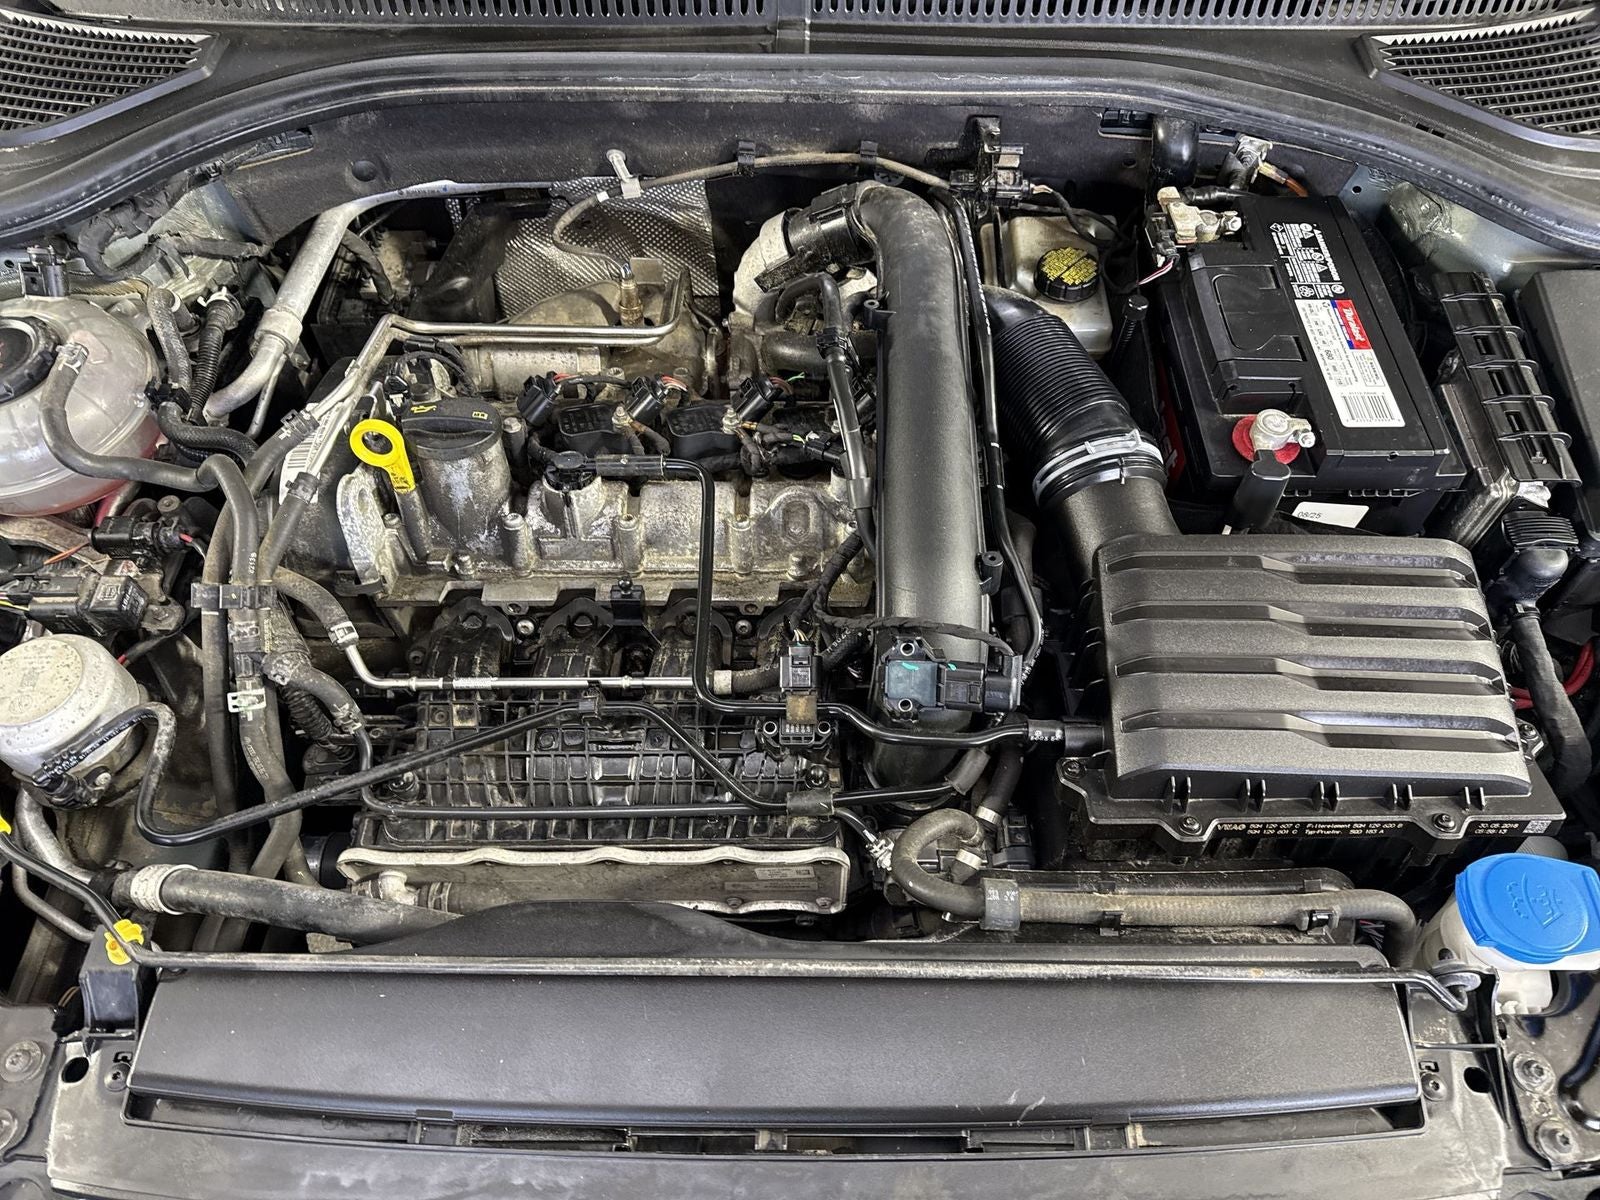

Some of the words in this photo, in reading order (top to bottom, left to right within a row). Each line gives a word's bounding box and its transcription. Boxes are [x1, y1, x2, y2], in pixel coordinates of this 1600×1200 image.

[1342, 307, 1366, 342] Duralast
[1323, 349, 1334, 360] 680
[1297, 511, 1322, 519] 08/25
